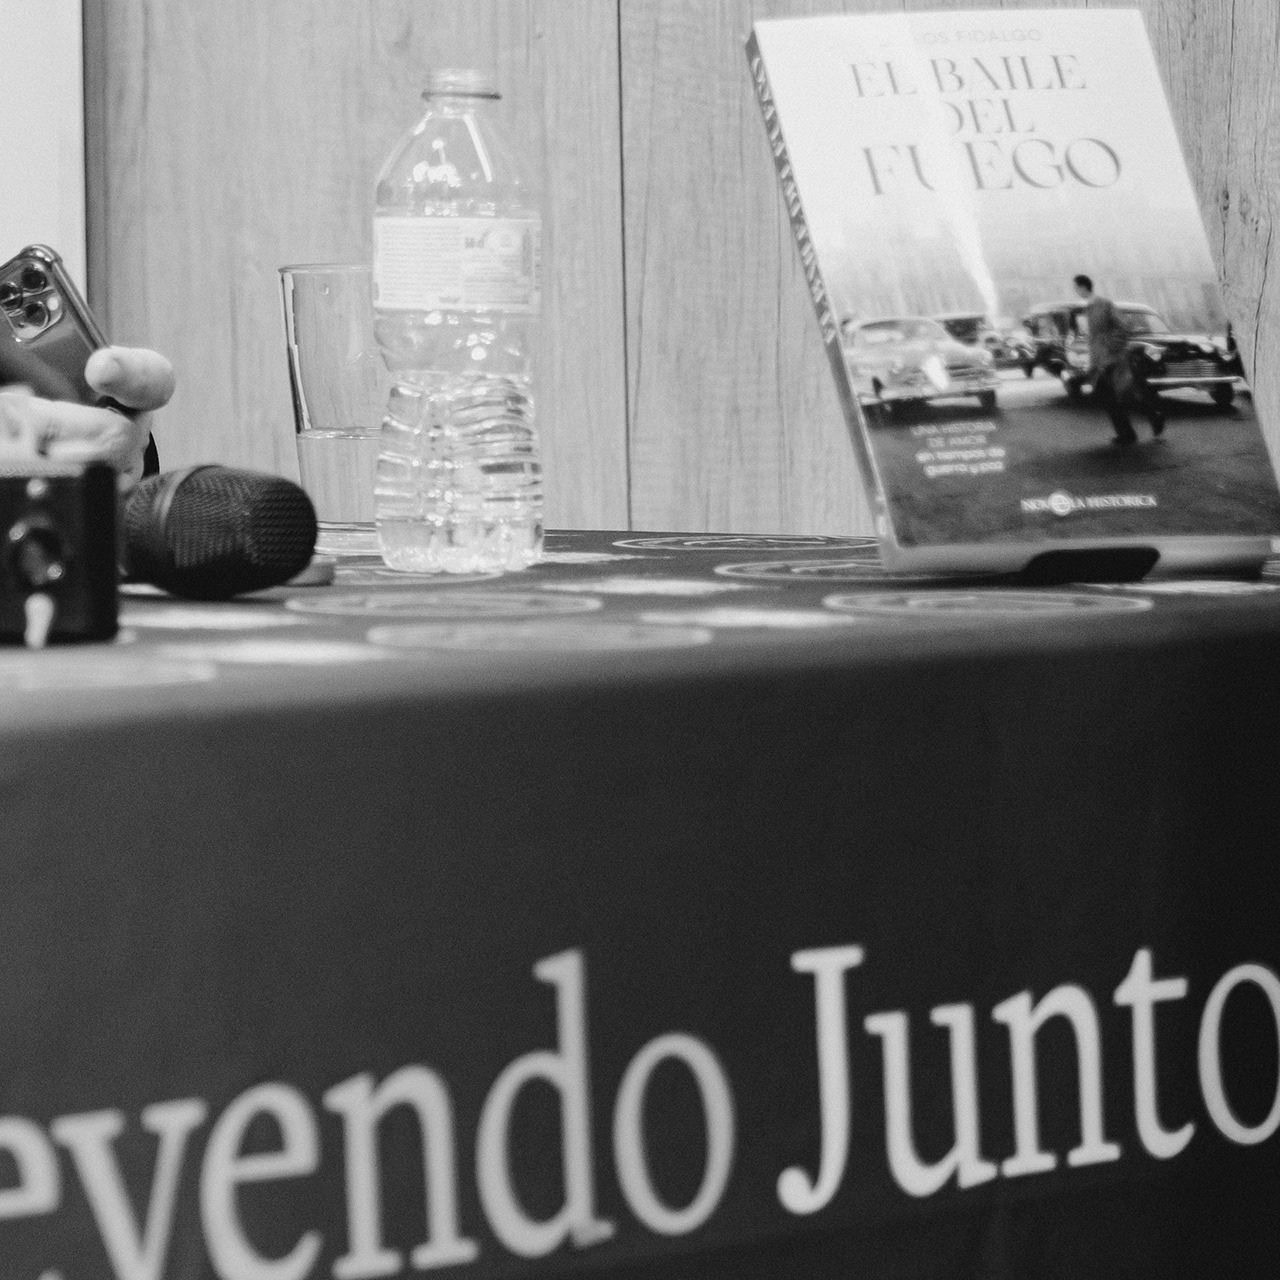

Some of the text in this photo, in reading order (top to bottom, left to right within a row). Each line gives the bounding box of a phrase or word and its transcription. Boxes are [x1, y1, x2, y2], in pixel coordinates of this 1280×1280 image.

[848, 54, 1087, 98] EL BAILE
[861, 137, 1122, 196] FUEGO
